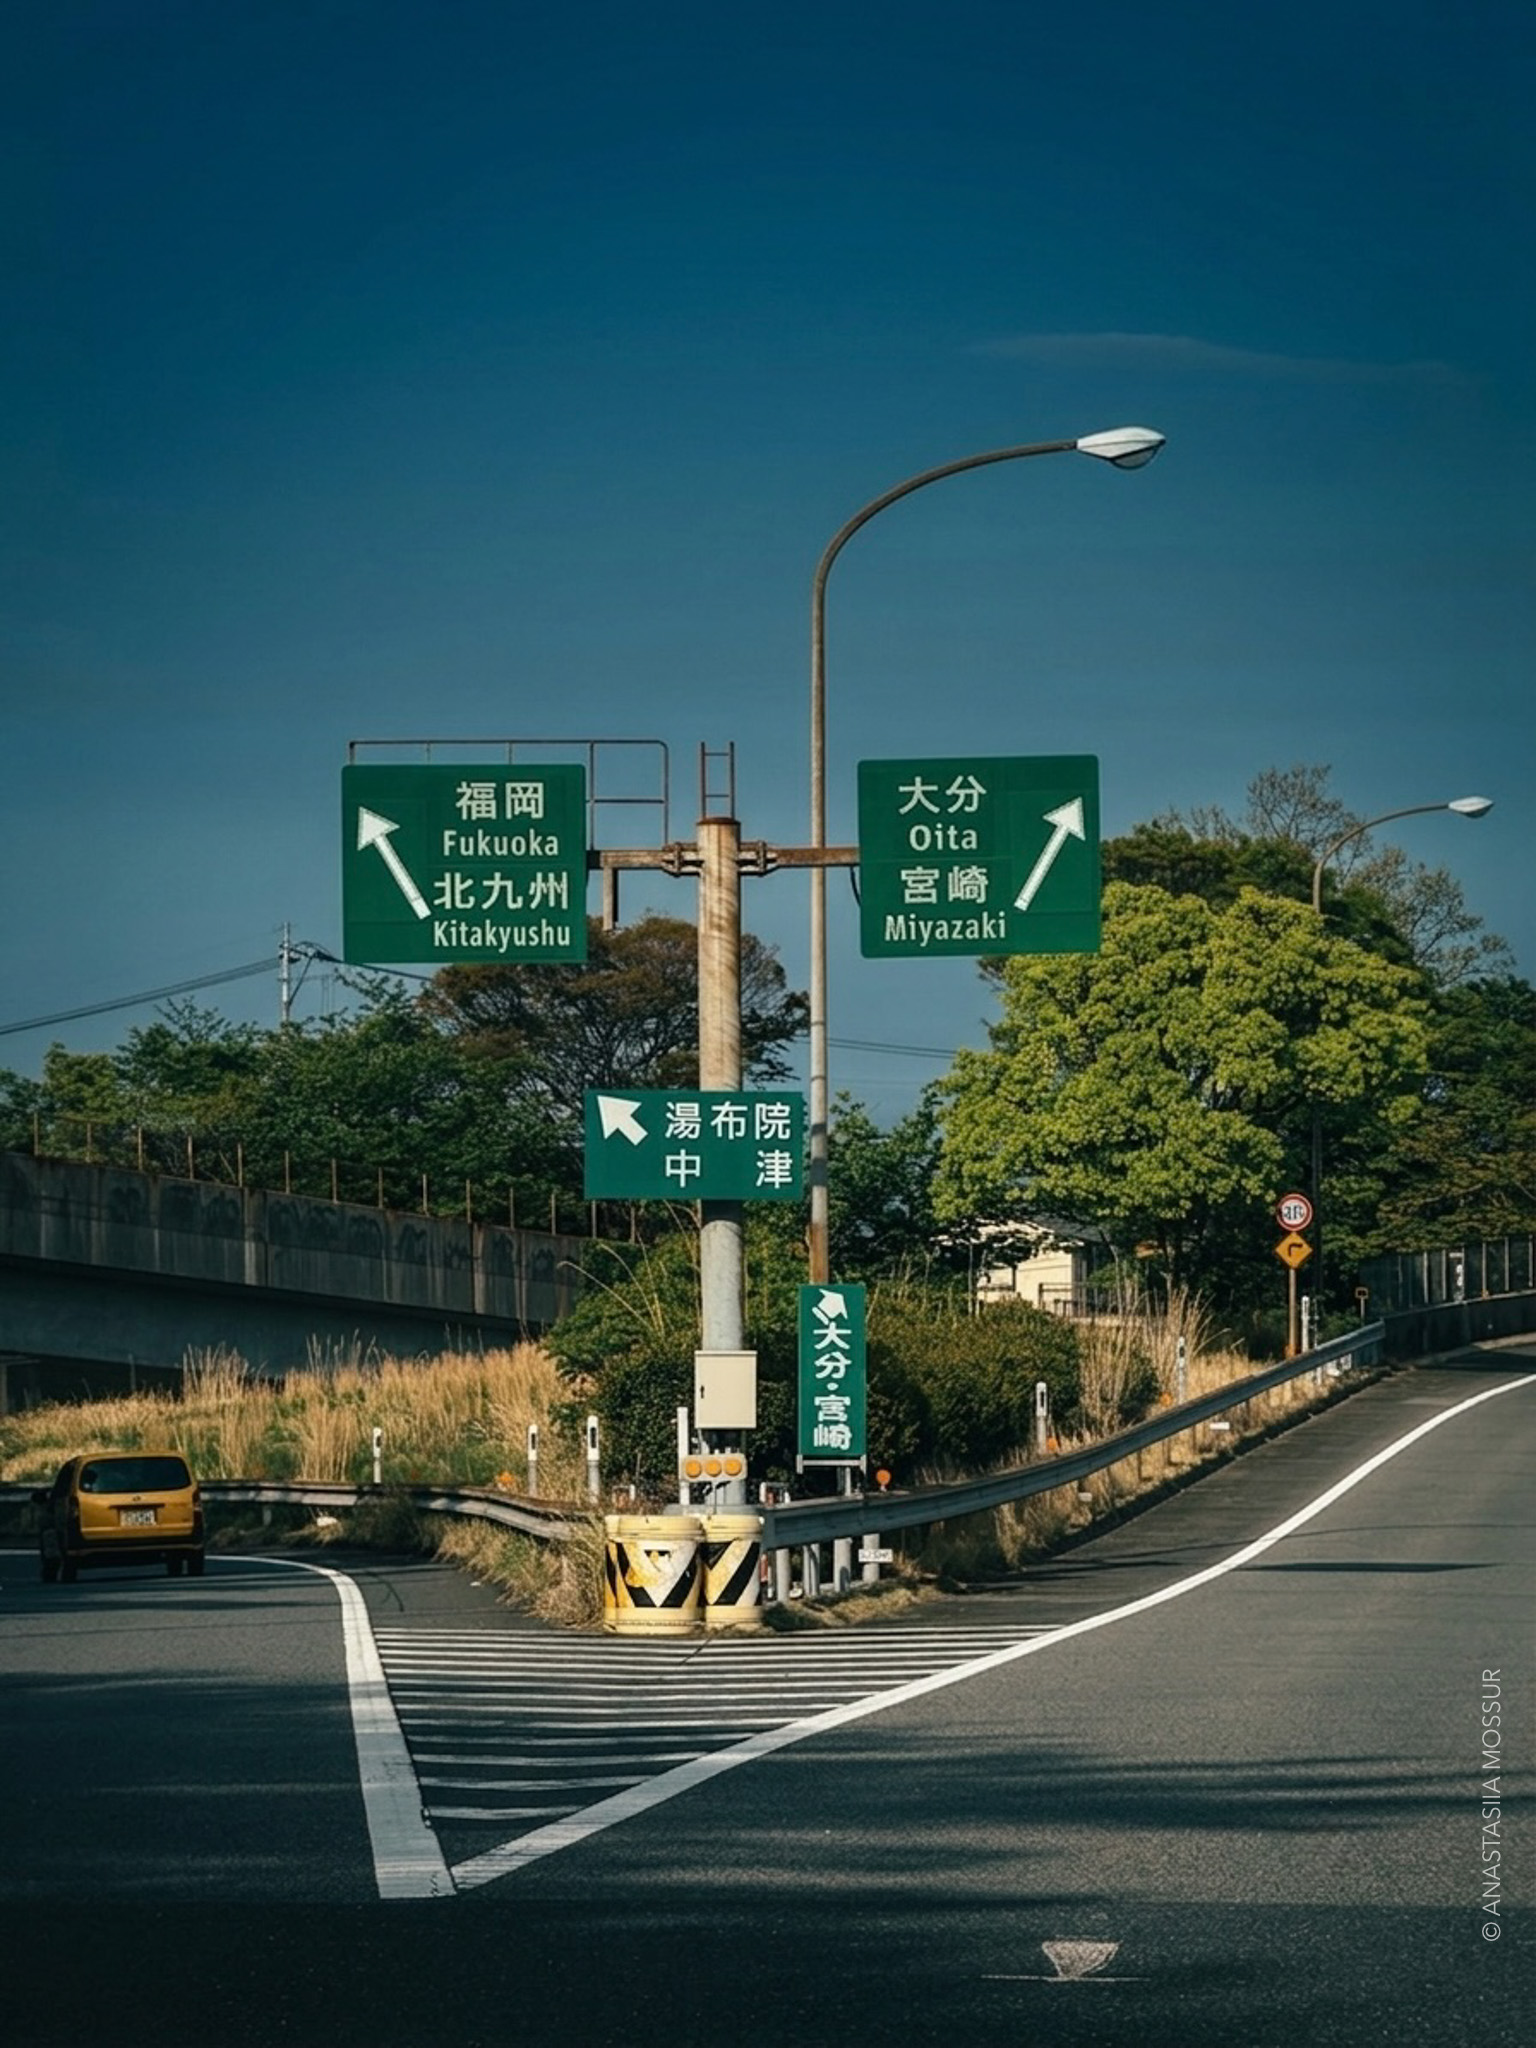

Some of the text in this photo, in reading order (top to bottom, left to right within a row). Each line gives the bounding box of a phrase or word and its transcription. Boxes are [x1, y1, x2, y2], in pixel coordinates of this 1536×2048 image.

[456, 782, 543, 819] 福岡
[899, 776, 986, 814] 大分
[444, 829, 559, 856] Fukuoka
[910, 823, 977, 850] Oita
[434, 872, 568, 910] 北九州
[901, 866, 988, 903] 宮崎
[434, 919, 570, 953] Kitakyushu
[885, 911, 1006, 947] Miyazaki
[665, 1101, 792, 1140] 湯布院
